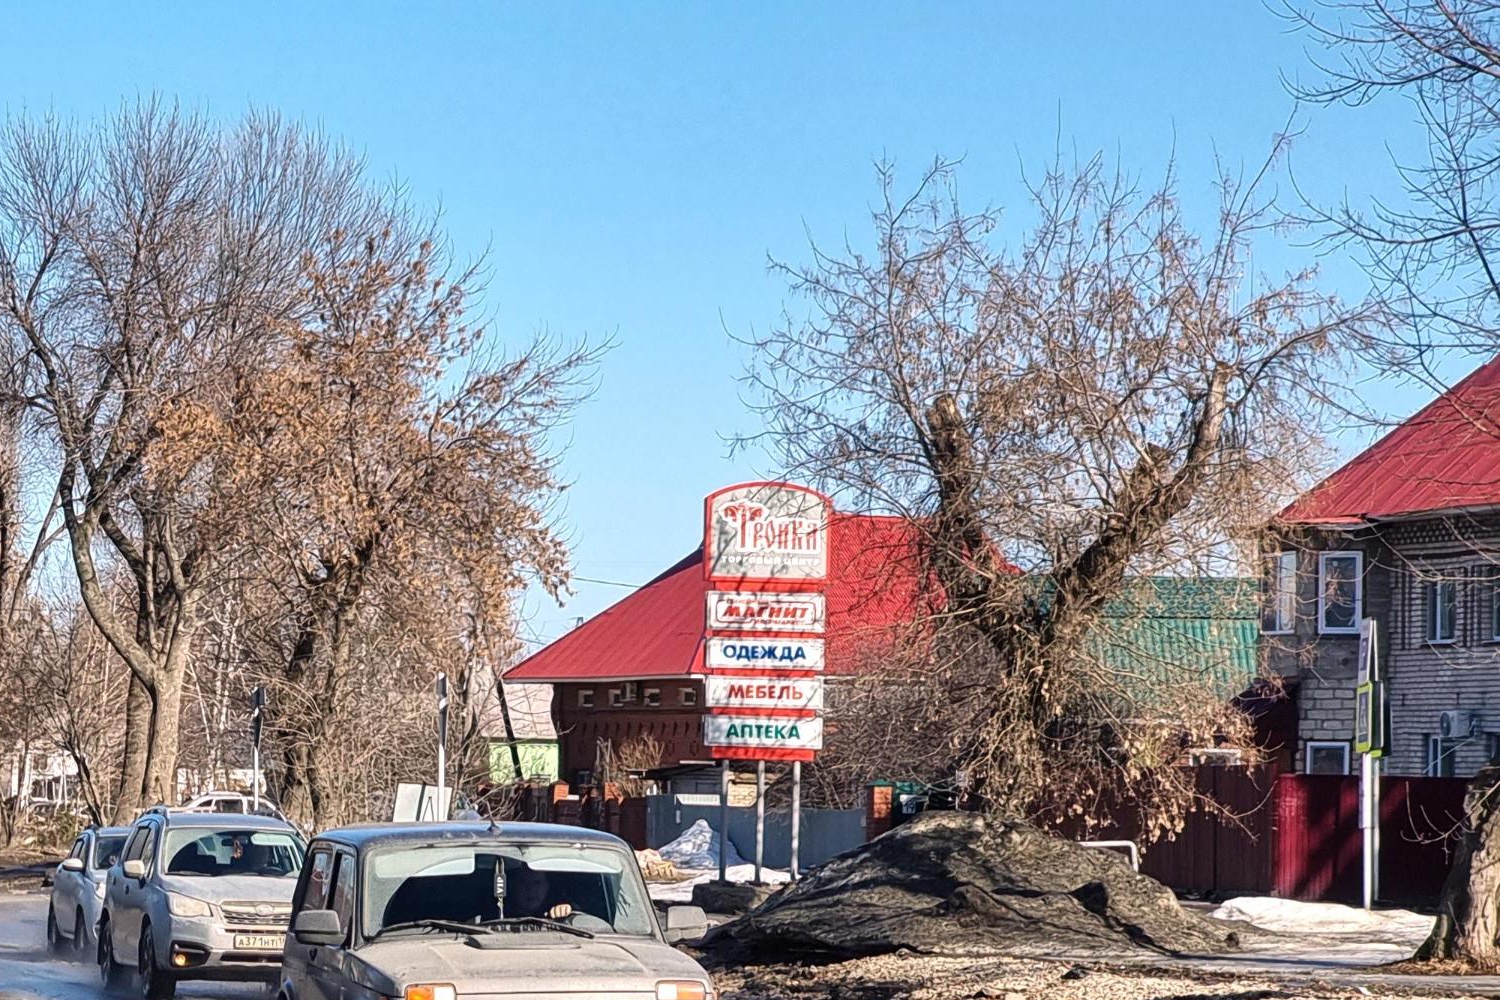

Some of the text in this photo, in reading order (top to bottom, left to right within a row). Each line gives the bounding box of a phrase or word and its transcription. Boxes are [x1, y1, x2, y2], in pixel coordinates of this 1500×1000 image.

[723, 605, 808, 618] МАГНИТ
[723, 645, 806, 662] ОДЕЖДА
[729, 684, 803, 700] МЕБЕЛЬ
[726, 724, 801, 740] АПТЕКА
[496, 876, 504, 894] VIP
